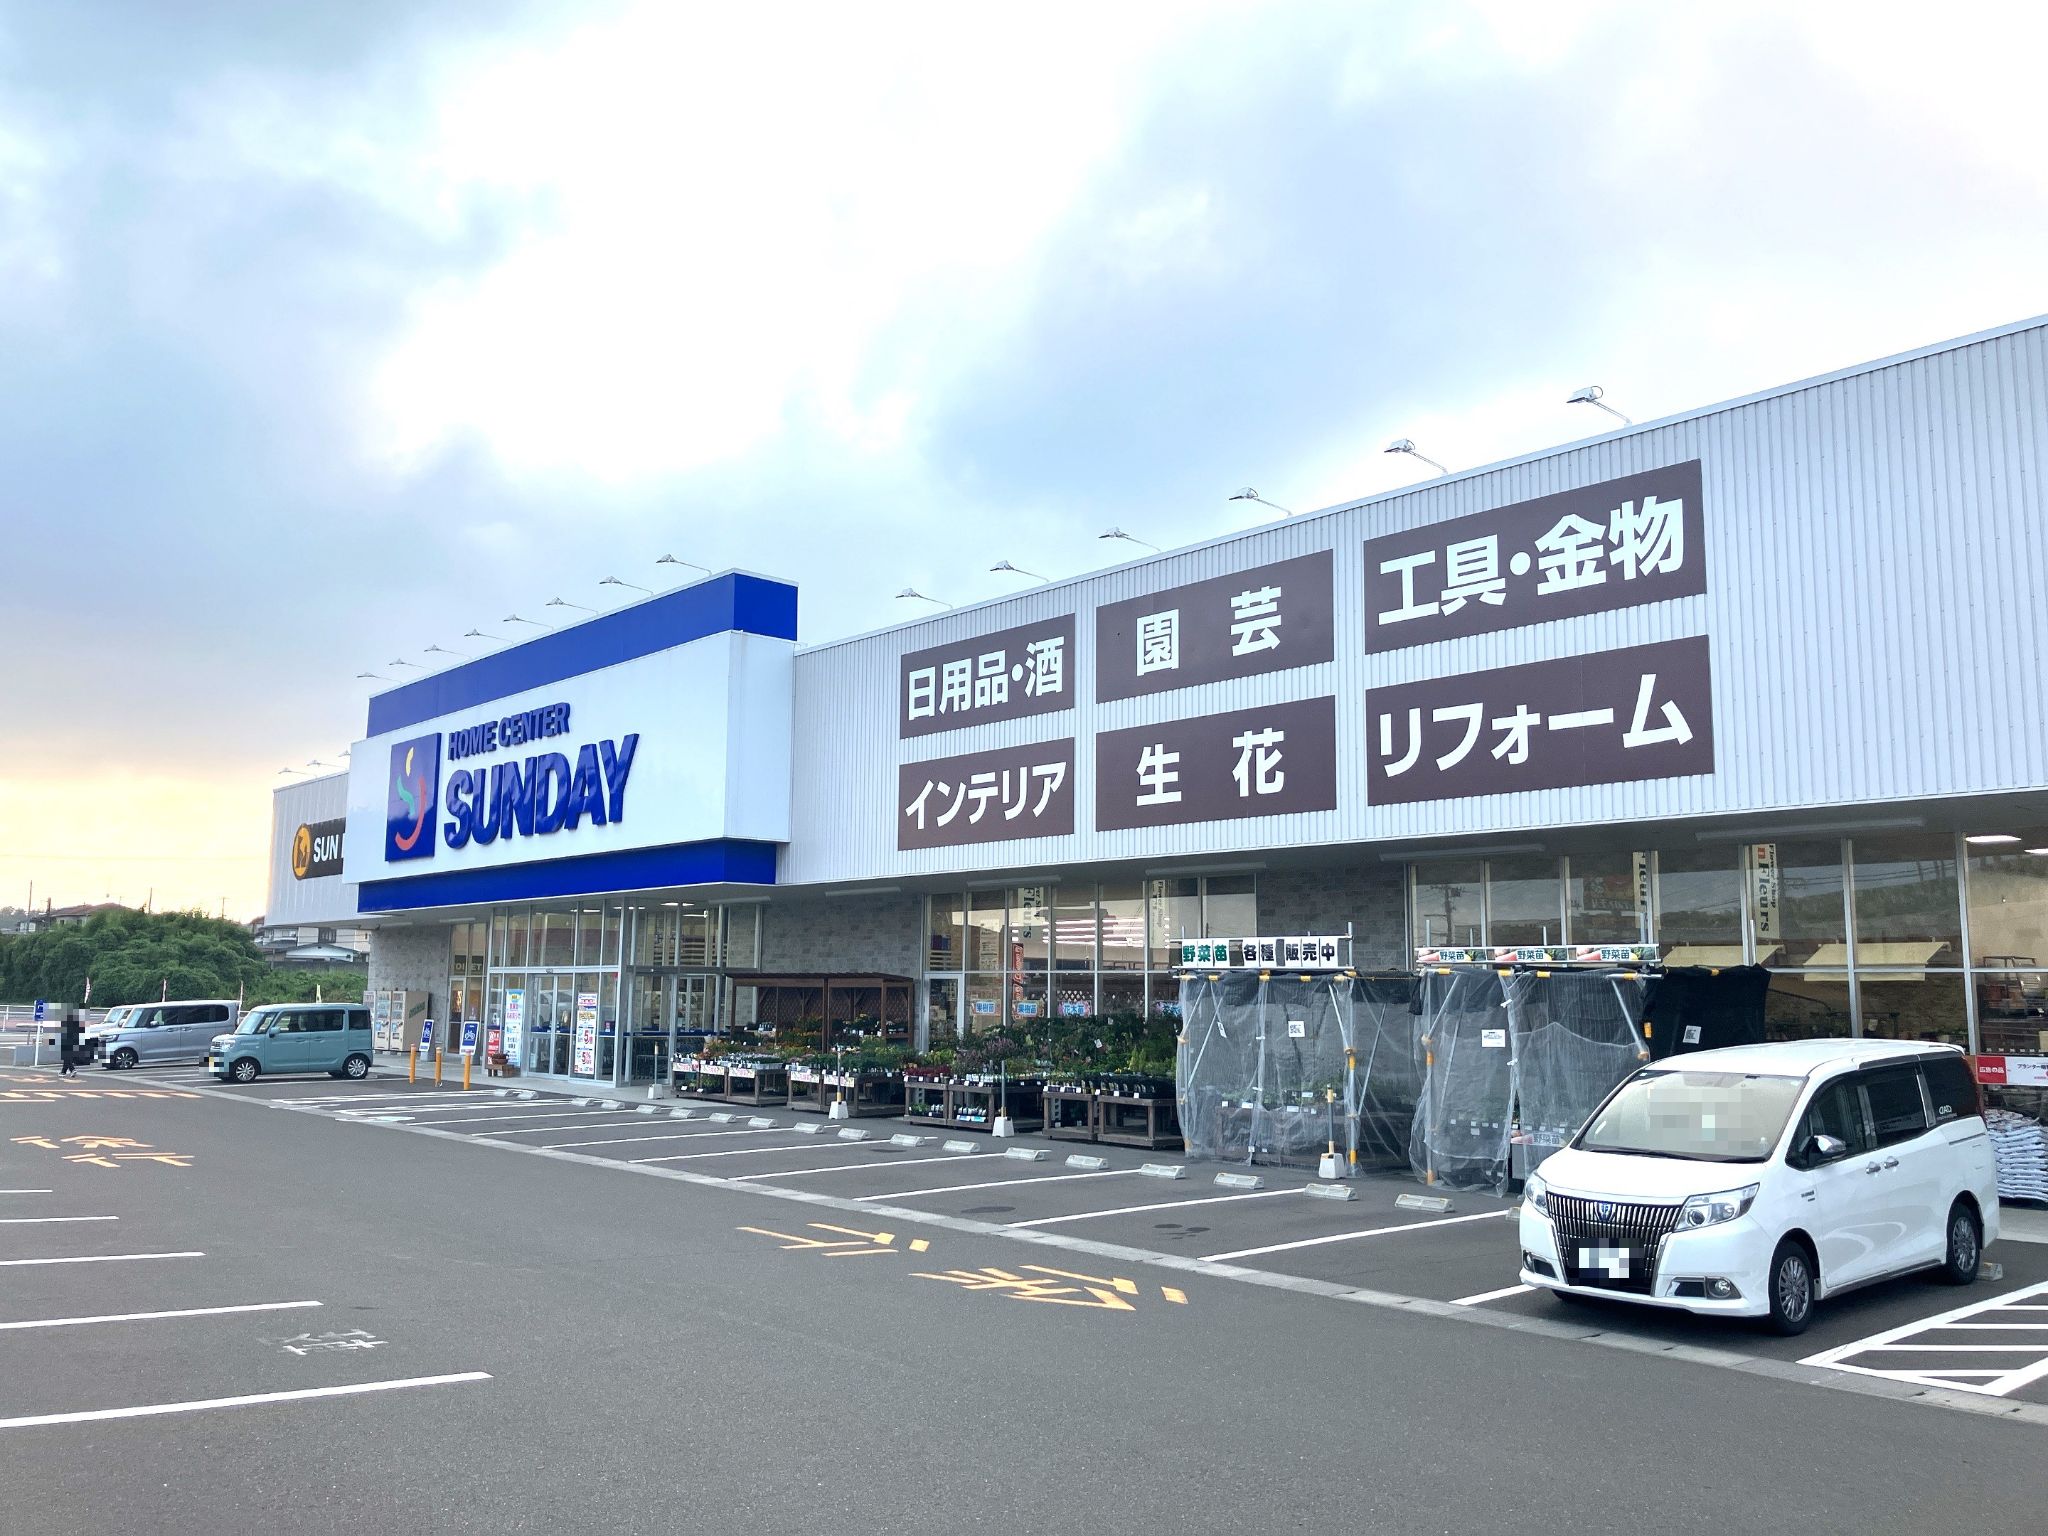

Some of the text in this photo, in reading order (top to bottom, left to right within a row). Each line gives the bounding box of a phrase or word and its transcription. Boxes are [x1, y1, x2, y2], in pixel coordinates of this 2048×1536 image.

[1379, 496, 1684, 626] 工具・金物
[908, 636, 1065, 721] 日用品・酒
[448, 702, 571, 761] HOME CENTER
[1379, 673, 1694, 778] リフォーム
[444, 723, 640, 850] SUNDAY
[904, 761, 1067, 830] インテリア
[313, 834, 339, 863] SUN
[1758, 862, 1770, 932] Fleurs
[1183, 942, 1336, 963] 野菜苗 各種 販売中
[1439, 950, 1465, 961] 野菜苗
[1517, 949, 1544, 960] 野菜苗
[1601, 949, 1630, 960] 野菜苗
